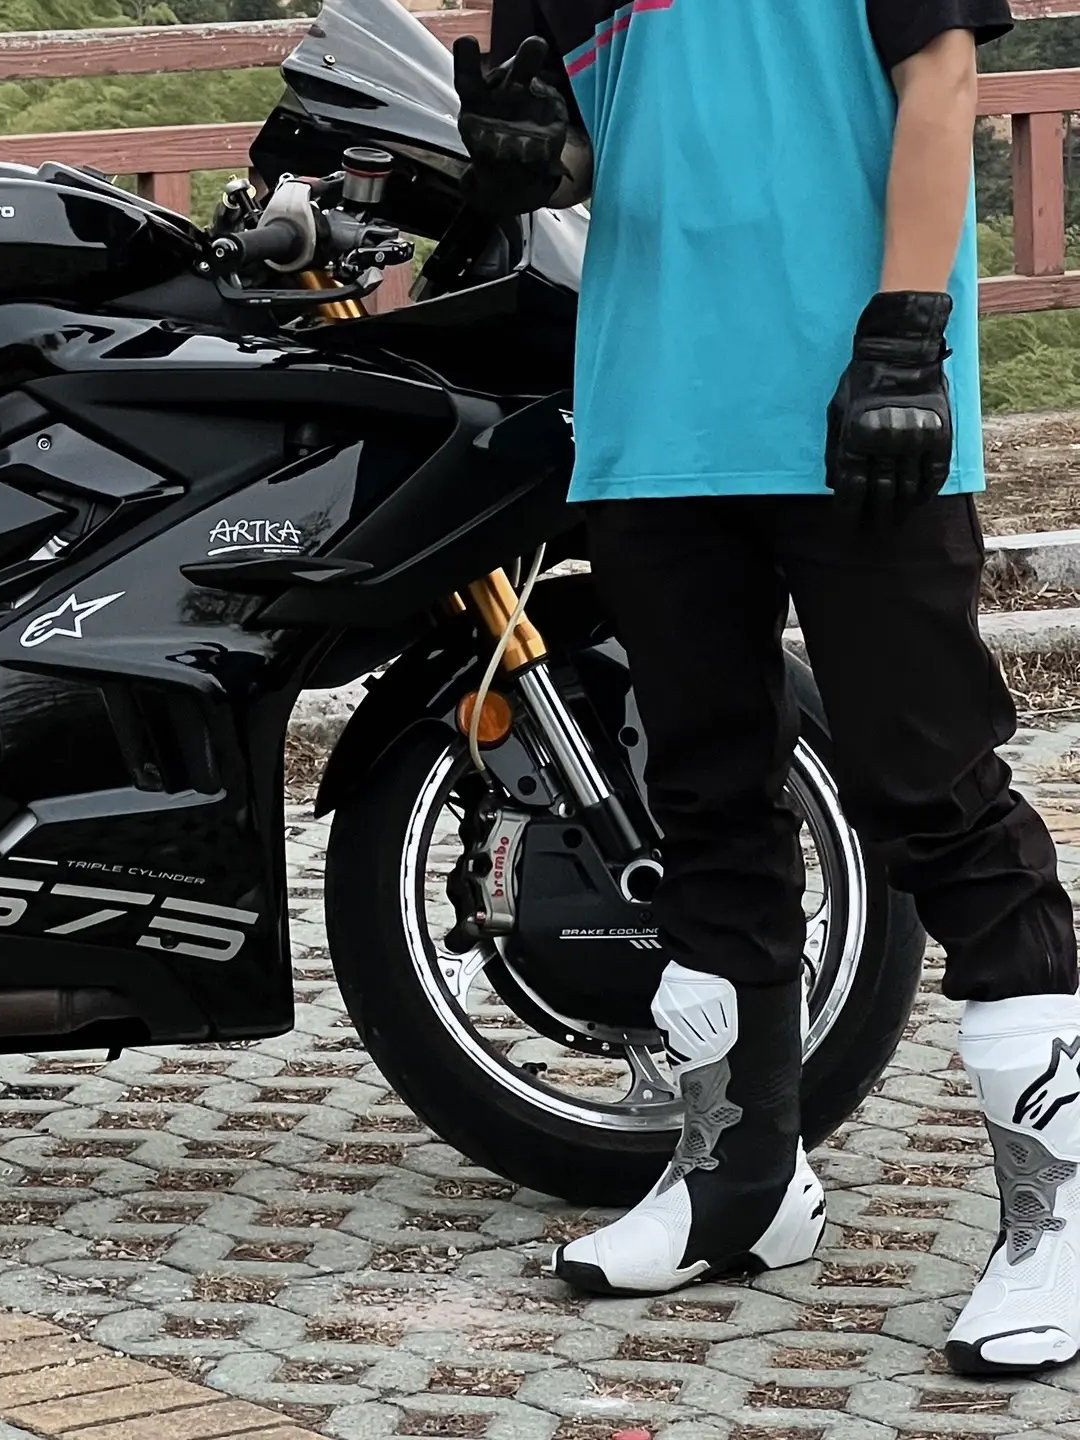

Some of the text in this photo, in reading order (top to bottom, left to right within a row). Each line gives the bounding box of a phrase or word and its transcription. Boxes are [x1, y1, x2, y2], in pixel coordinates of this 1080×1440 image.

[209, 519, 301, 544] ARTKA
[67, 860, 206, 885] TRIPLE CYLINDER
[491, 836, 510, 898] brembo
[561, 928, 604, 936] BRAKE
